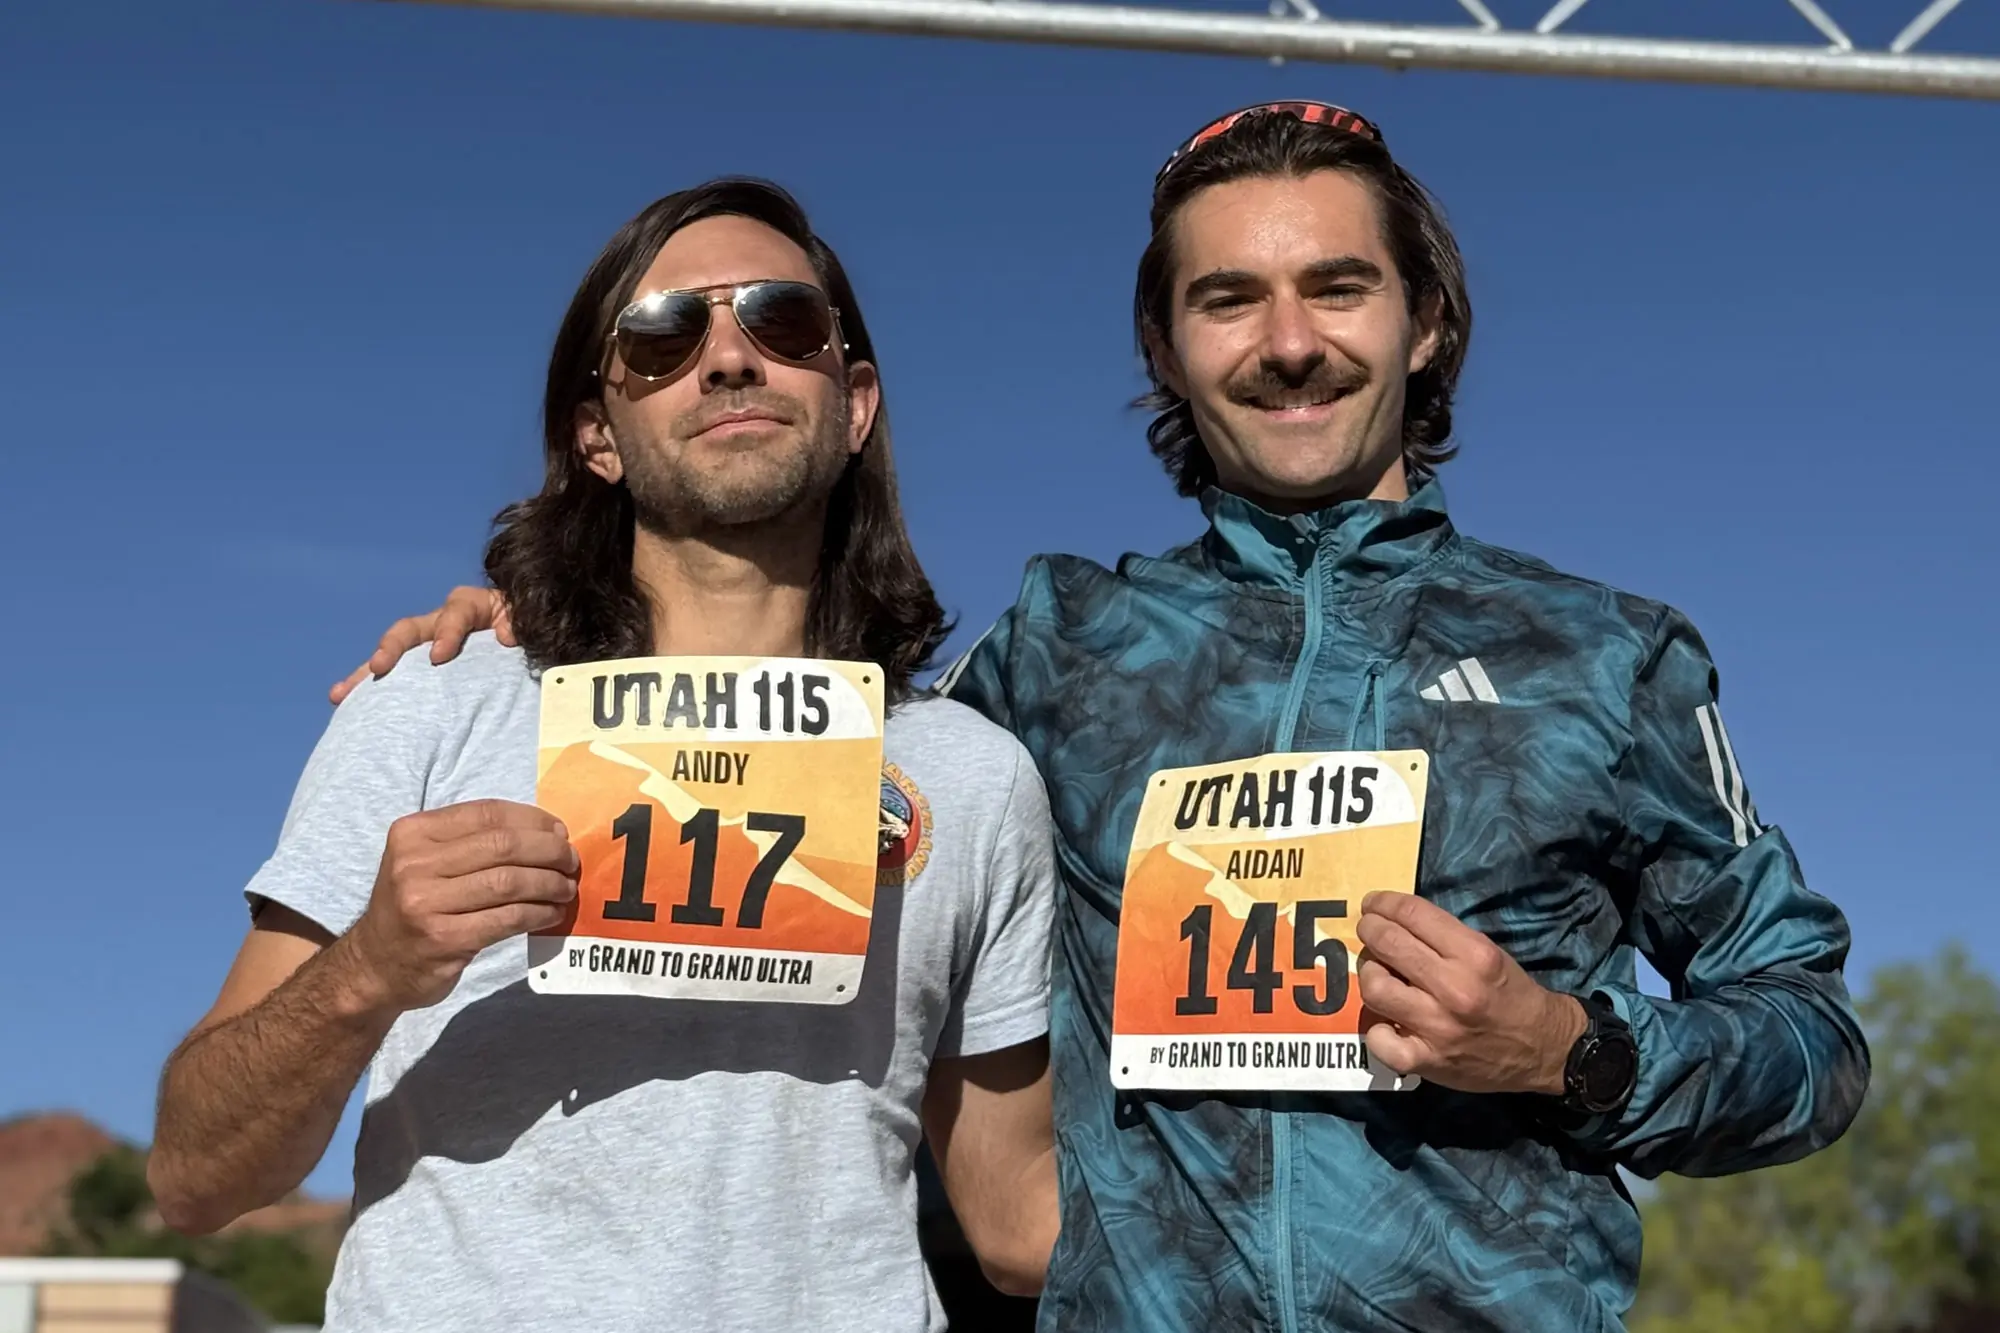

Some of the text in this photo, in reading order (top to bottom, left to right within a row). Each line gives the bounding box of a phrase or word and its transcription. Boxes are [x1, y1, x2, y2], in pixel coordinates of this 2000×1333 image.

[592, 670, 831, 735] UTAH 115
[672, 750, 750, 785] ANDY
[1174, 765, 1378, 830] UTAH 115
[602, 803, 806, 929] 117
[1225, 848, 1304, 880] AIDAN
[569, 944, 814, 985] BY GRAND TO GRAND ULTRA
[1175, 899, 1350, 1016] 145
[1150, 1042, 1369, 1069] BY GRAND TO GRAND ULTRA
